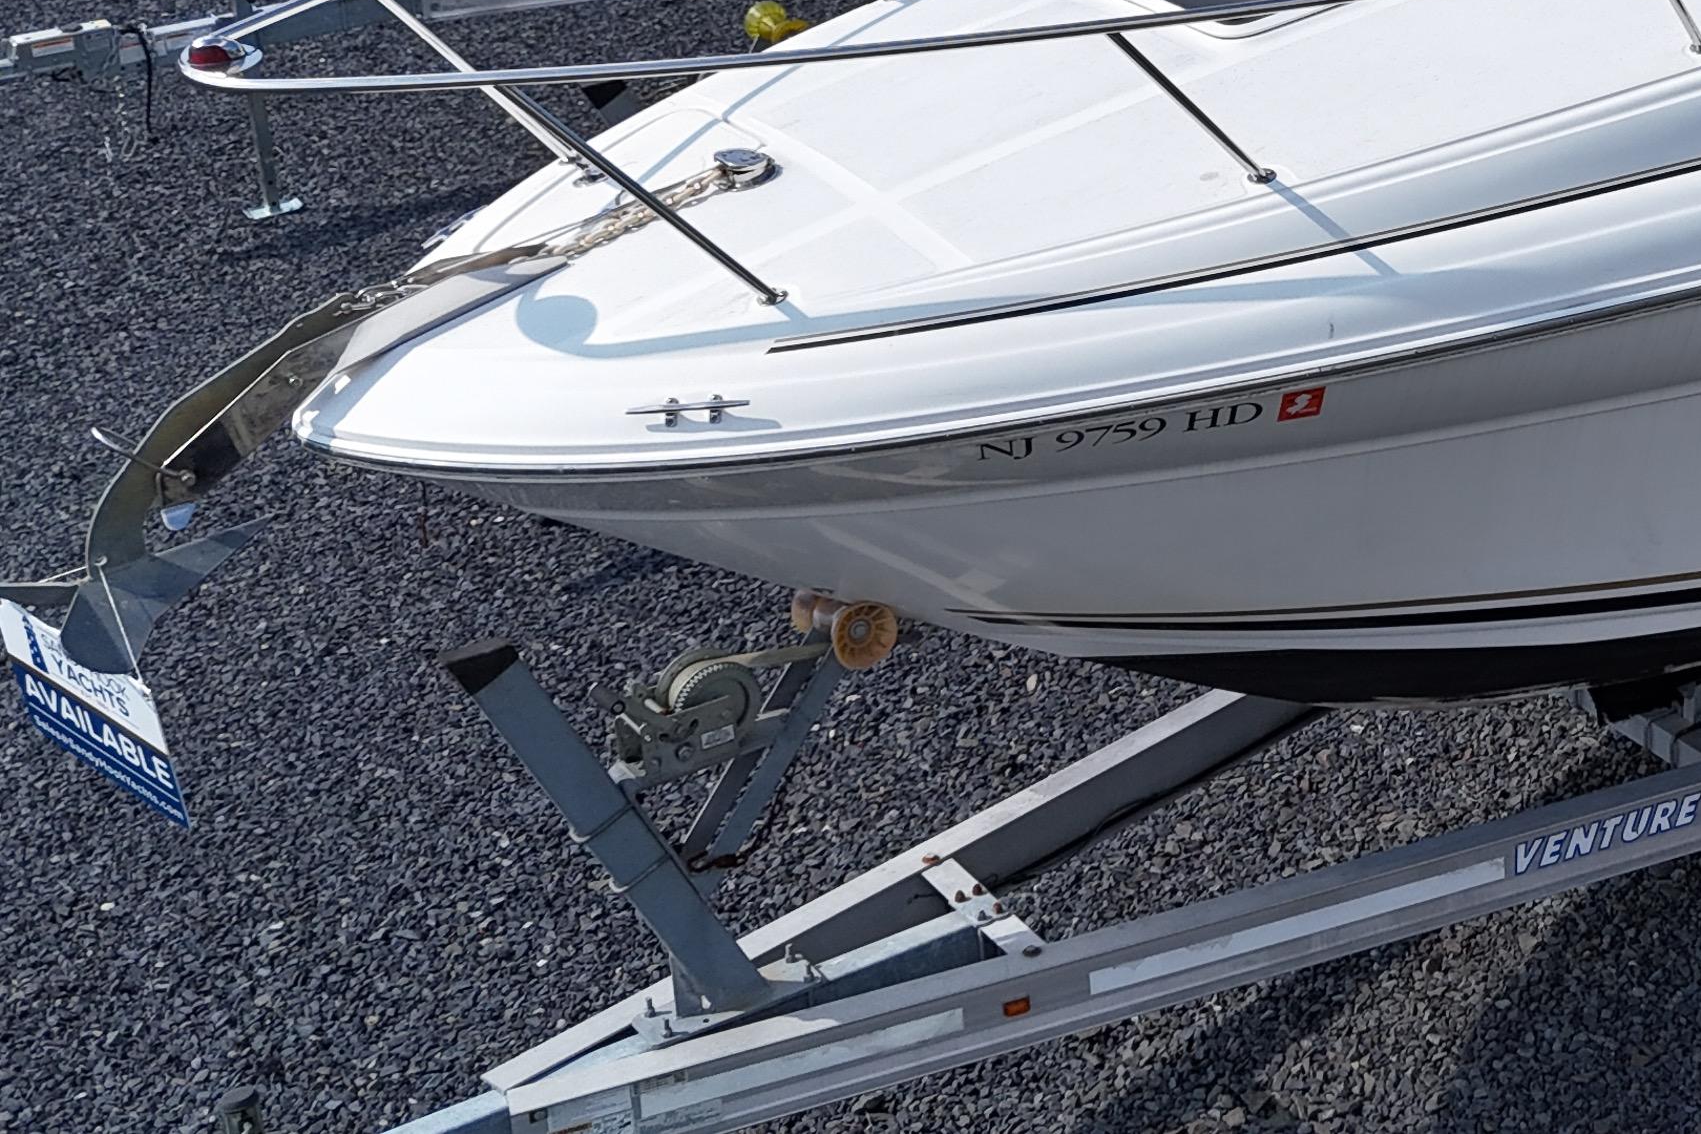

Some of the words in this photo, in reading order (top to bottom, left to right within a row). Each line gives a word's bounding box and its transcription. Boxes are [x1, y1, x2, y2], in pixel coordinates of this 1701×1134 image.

[977, 436, 1036, 461] NJ
[1056, 416, 1167, 453] 9759
[1183, 401, 1263, 433] HD
[50, 651, 130, 717] YACHTS
[24, 673, 174, 790] AVAILABLE
